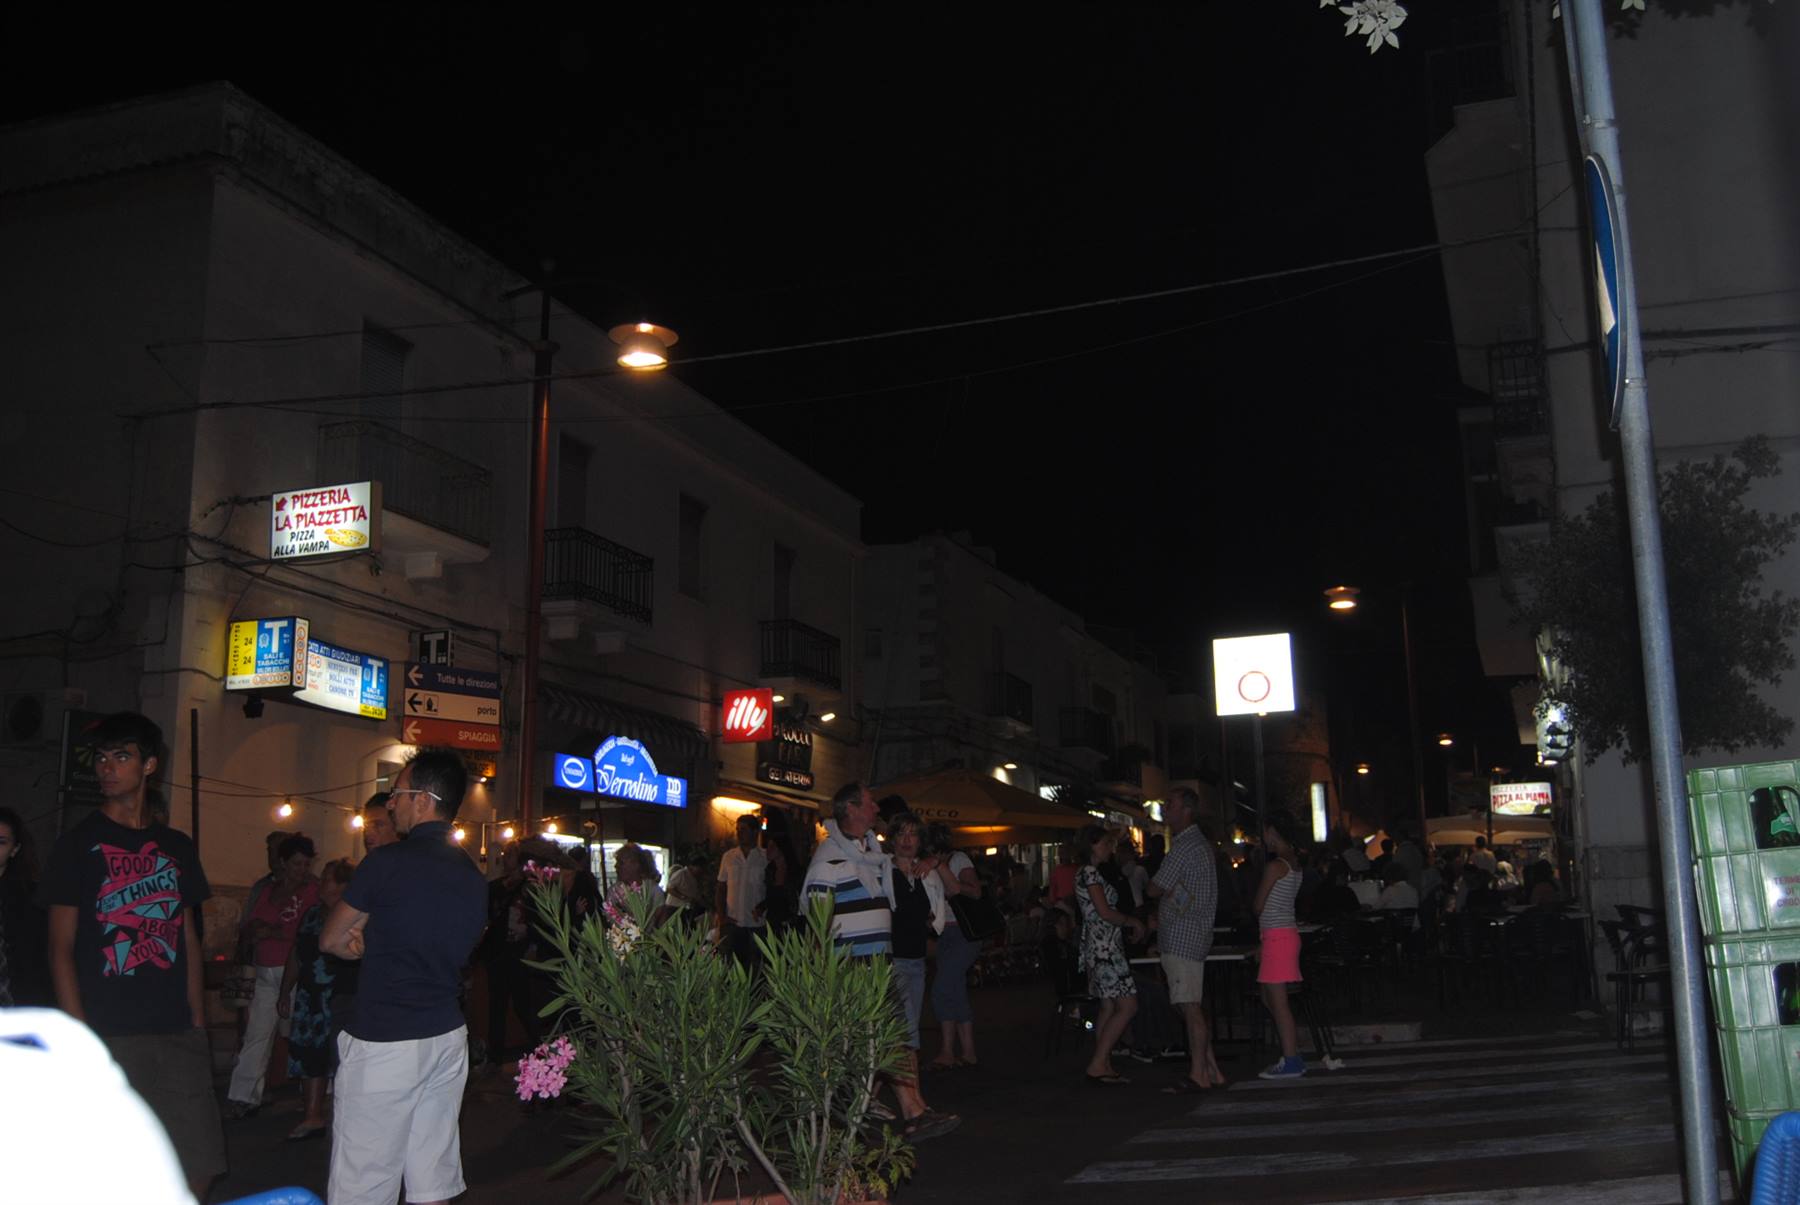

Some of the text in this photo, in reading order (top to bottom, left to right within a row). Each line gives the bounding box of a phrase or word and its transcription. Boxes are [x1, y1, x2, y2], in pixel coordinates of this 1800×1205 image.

[291, 487, 351, 510] PIZZERIA
[274, 505, 368, 532] LA PIAZZETTA
[290, 529, 315, 543] PIZZA
[274, 540, 330, 557] ALLA VAMPA
[264, 620, 289, 653] T
[257, 658, 290, 667] TABACCHI
[436, 672, 498, 690] Tutte le direzioni
[477, 705, 498, 717] porto
[726, 696, 767, 737] illy
[457, 730, 498, 744] SPIAGGIA
[1492, 794, 1514, 811] PIZZA
[1514, 793, 1524, 801] AL
[110, 856, 153, 876] GOOD
[119, 870, 177, 906] THINGS
[132, 940, 160, 962] YOU
